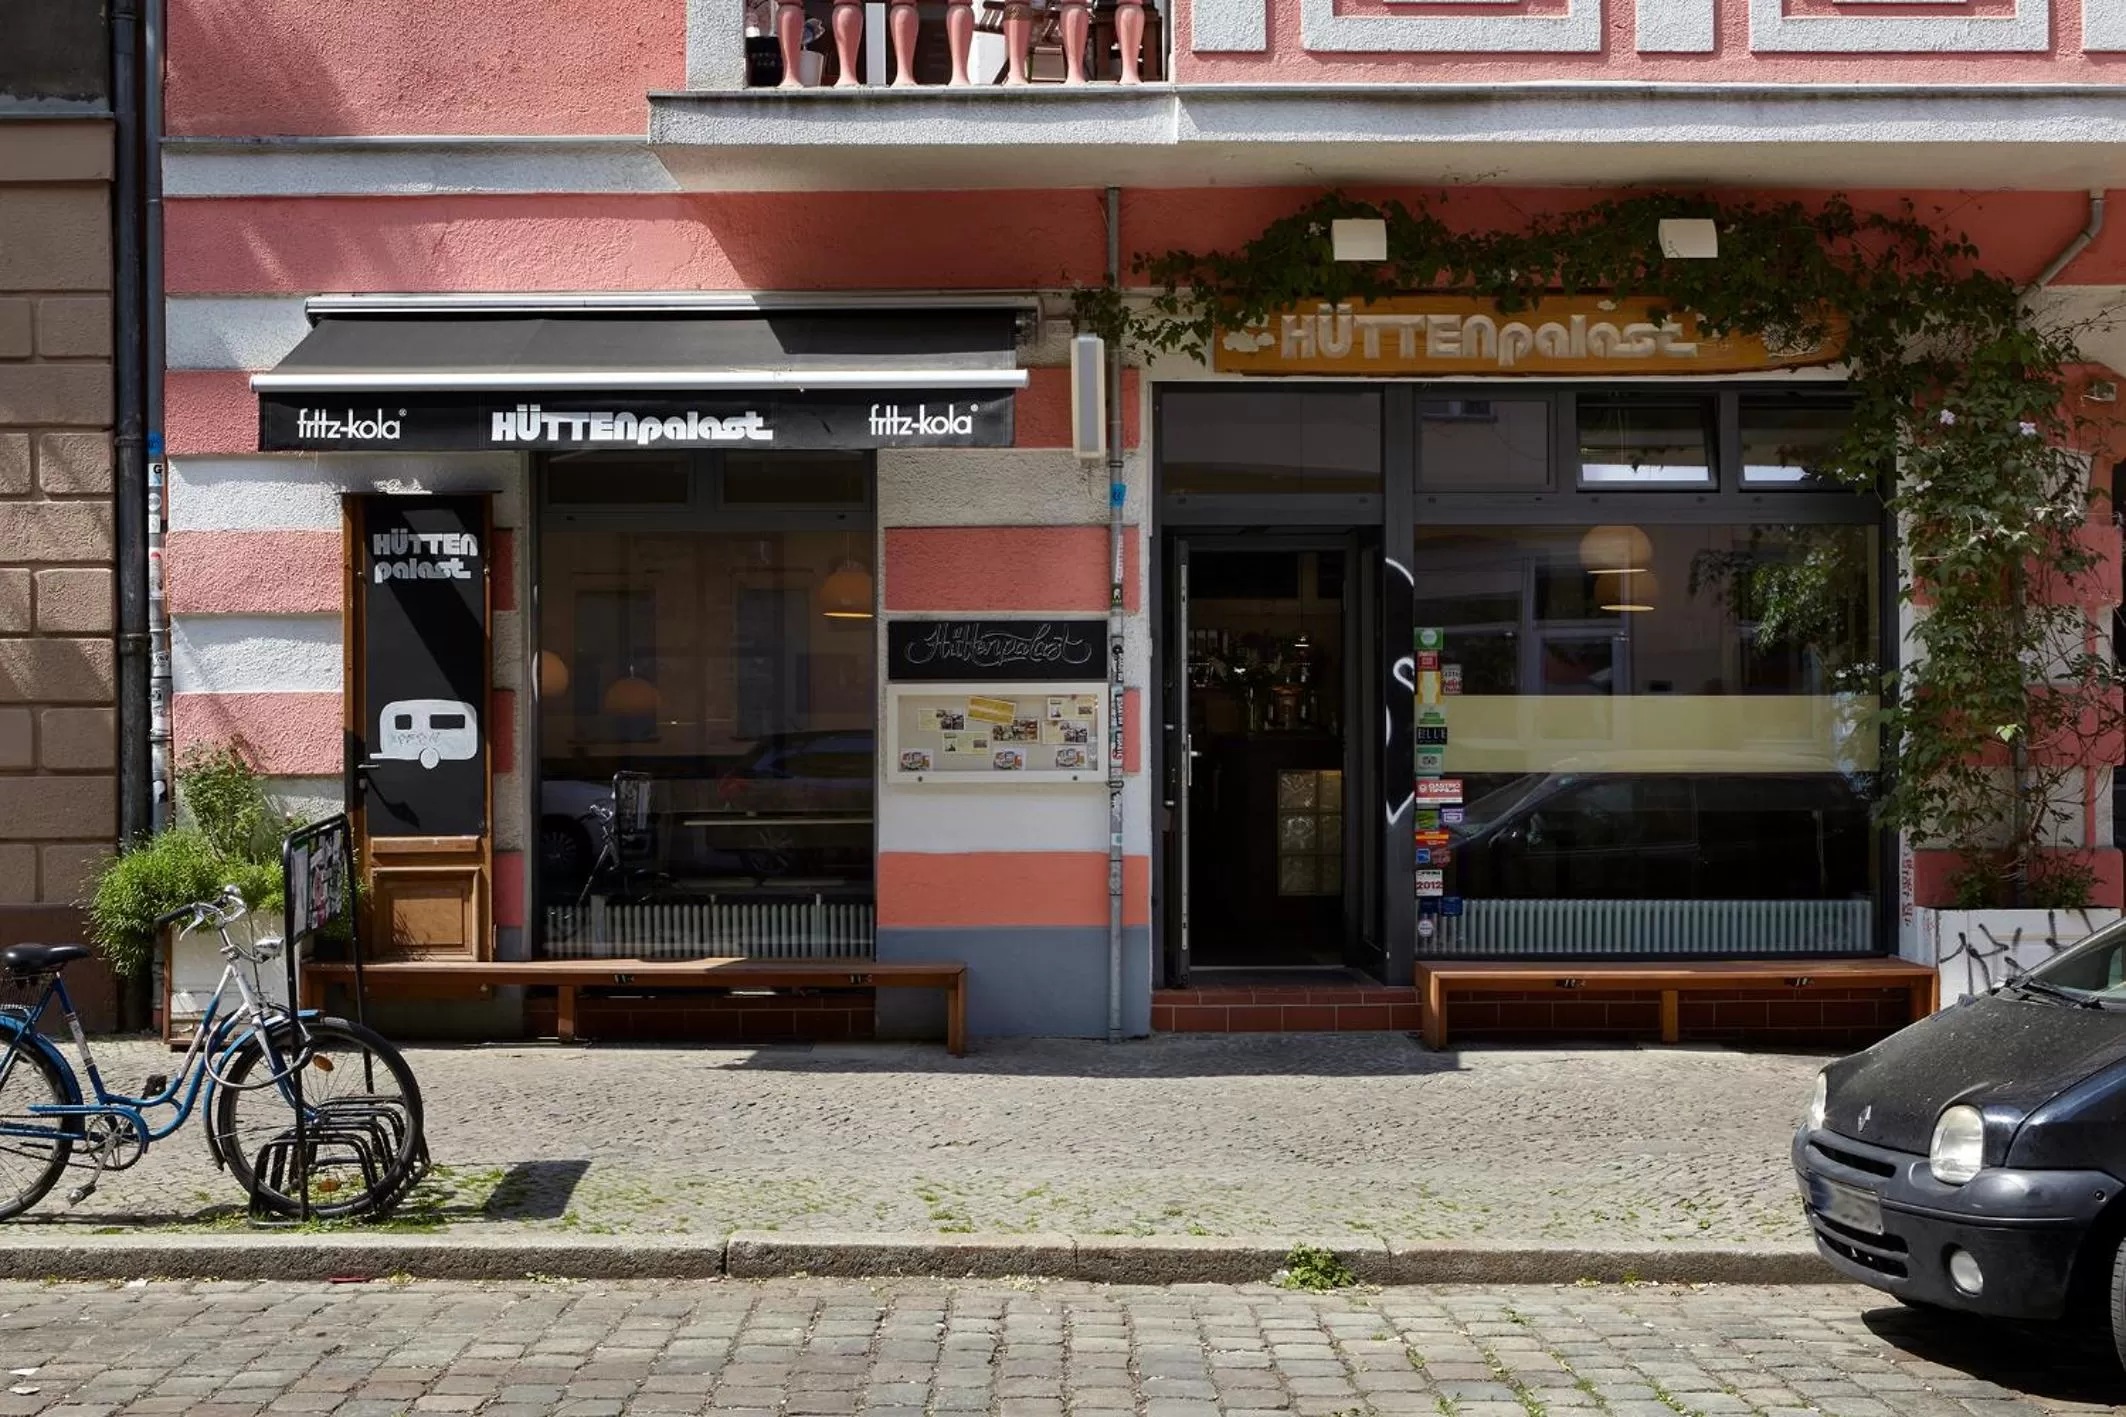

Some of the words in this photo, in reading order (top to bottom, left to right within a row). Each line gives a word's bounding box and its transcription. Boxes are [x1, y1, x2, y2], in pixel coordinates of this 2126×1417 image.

[1281, 303, 1699, 366] HÜTTENpalast
[491, 404, 774, 445] HÜTTENpalast
[373, 528, 479, 556] HÜTTEN
[374, 558, 472, 584] palast
[1416, 881, 1443, 890] 2012
